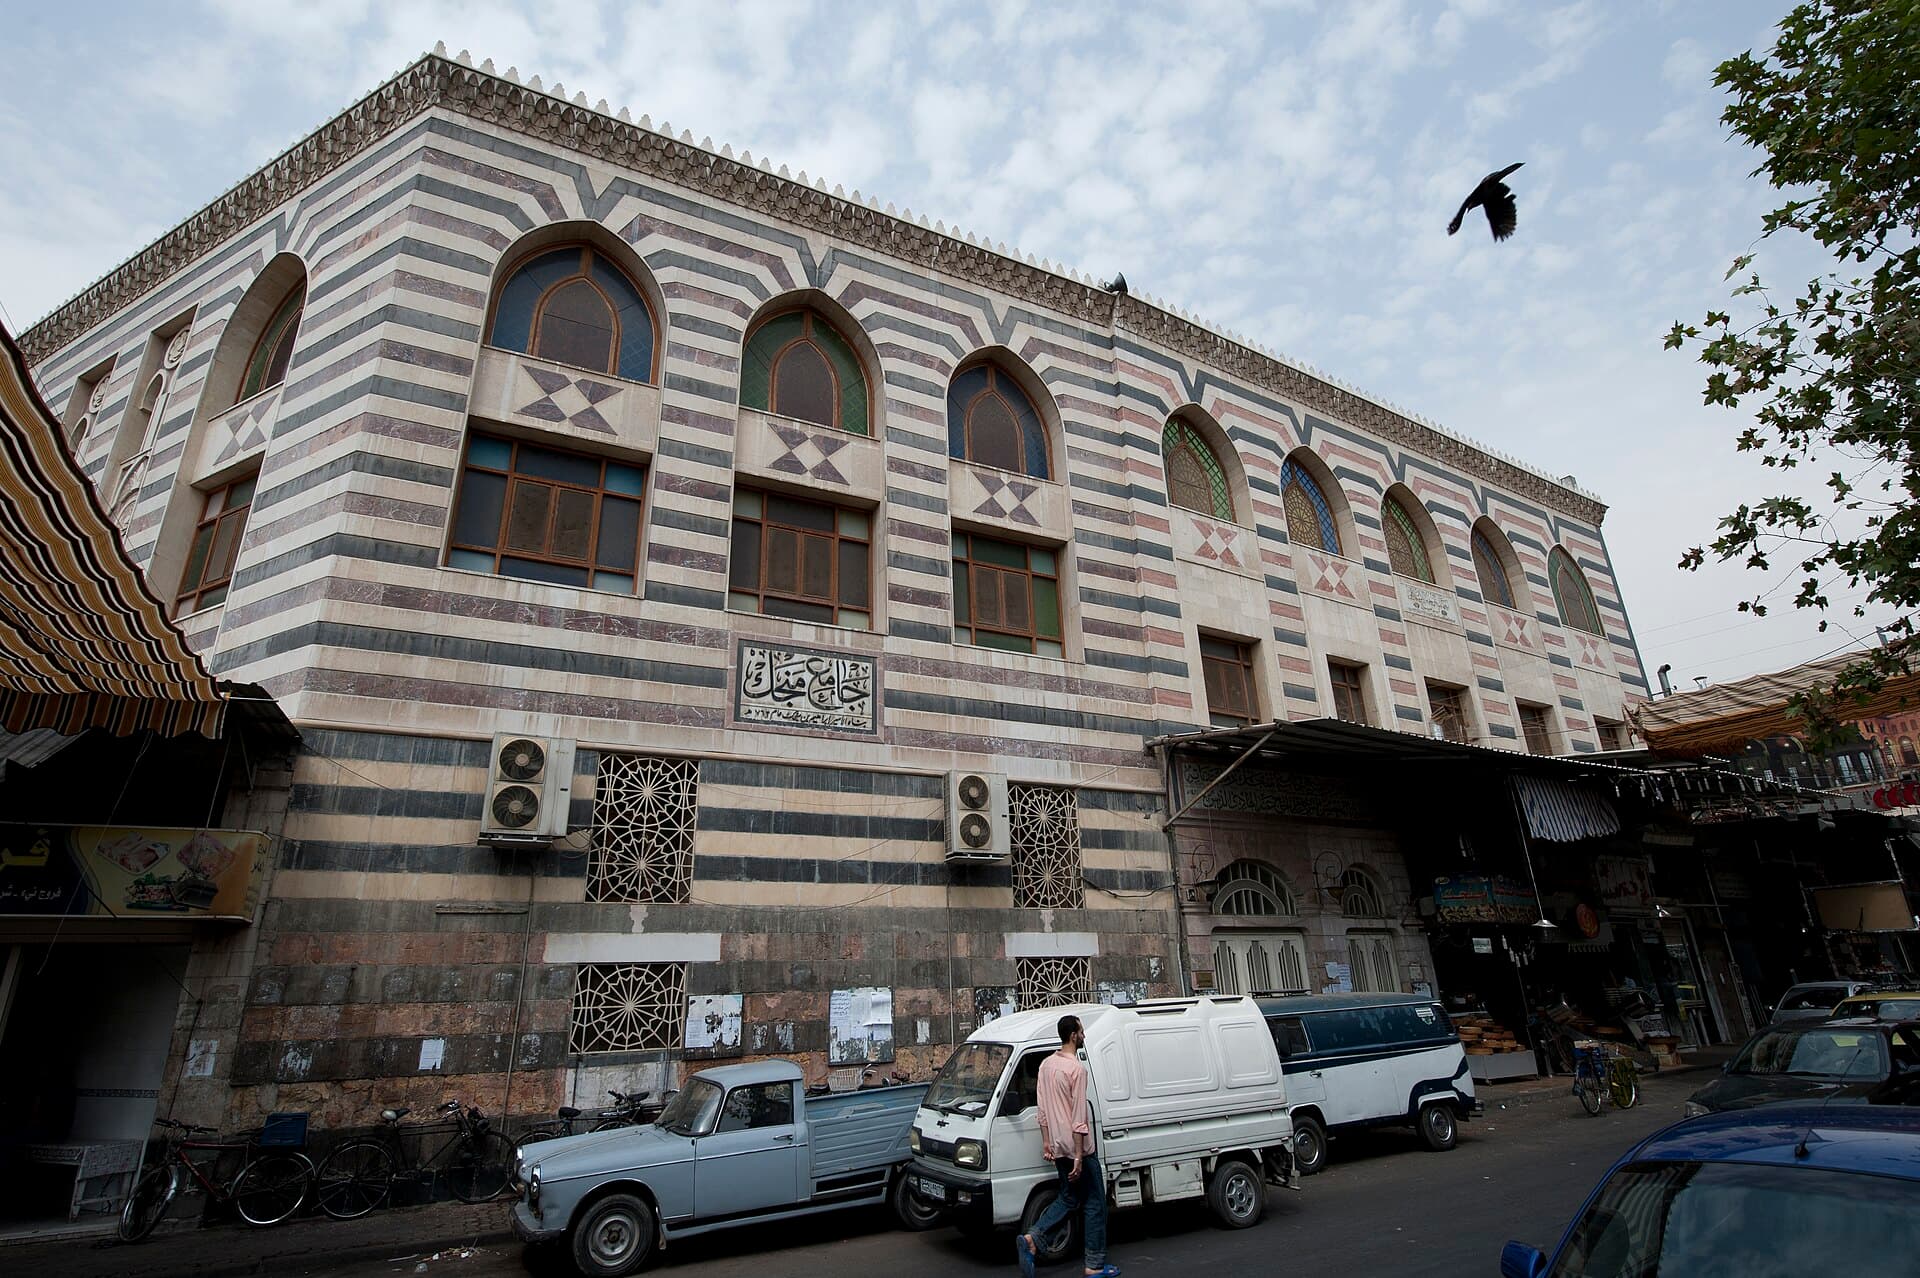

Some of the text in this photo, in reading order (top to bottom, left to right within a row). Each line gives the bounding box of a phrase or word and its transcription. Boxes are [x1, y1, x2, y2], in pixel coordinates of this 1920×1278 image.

[742, 650, 871, 712] جامع منجك
[38, 886, 62, 900] فروج
